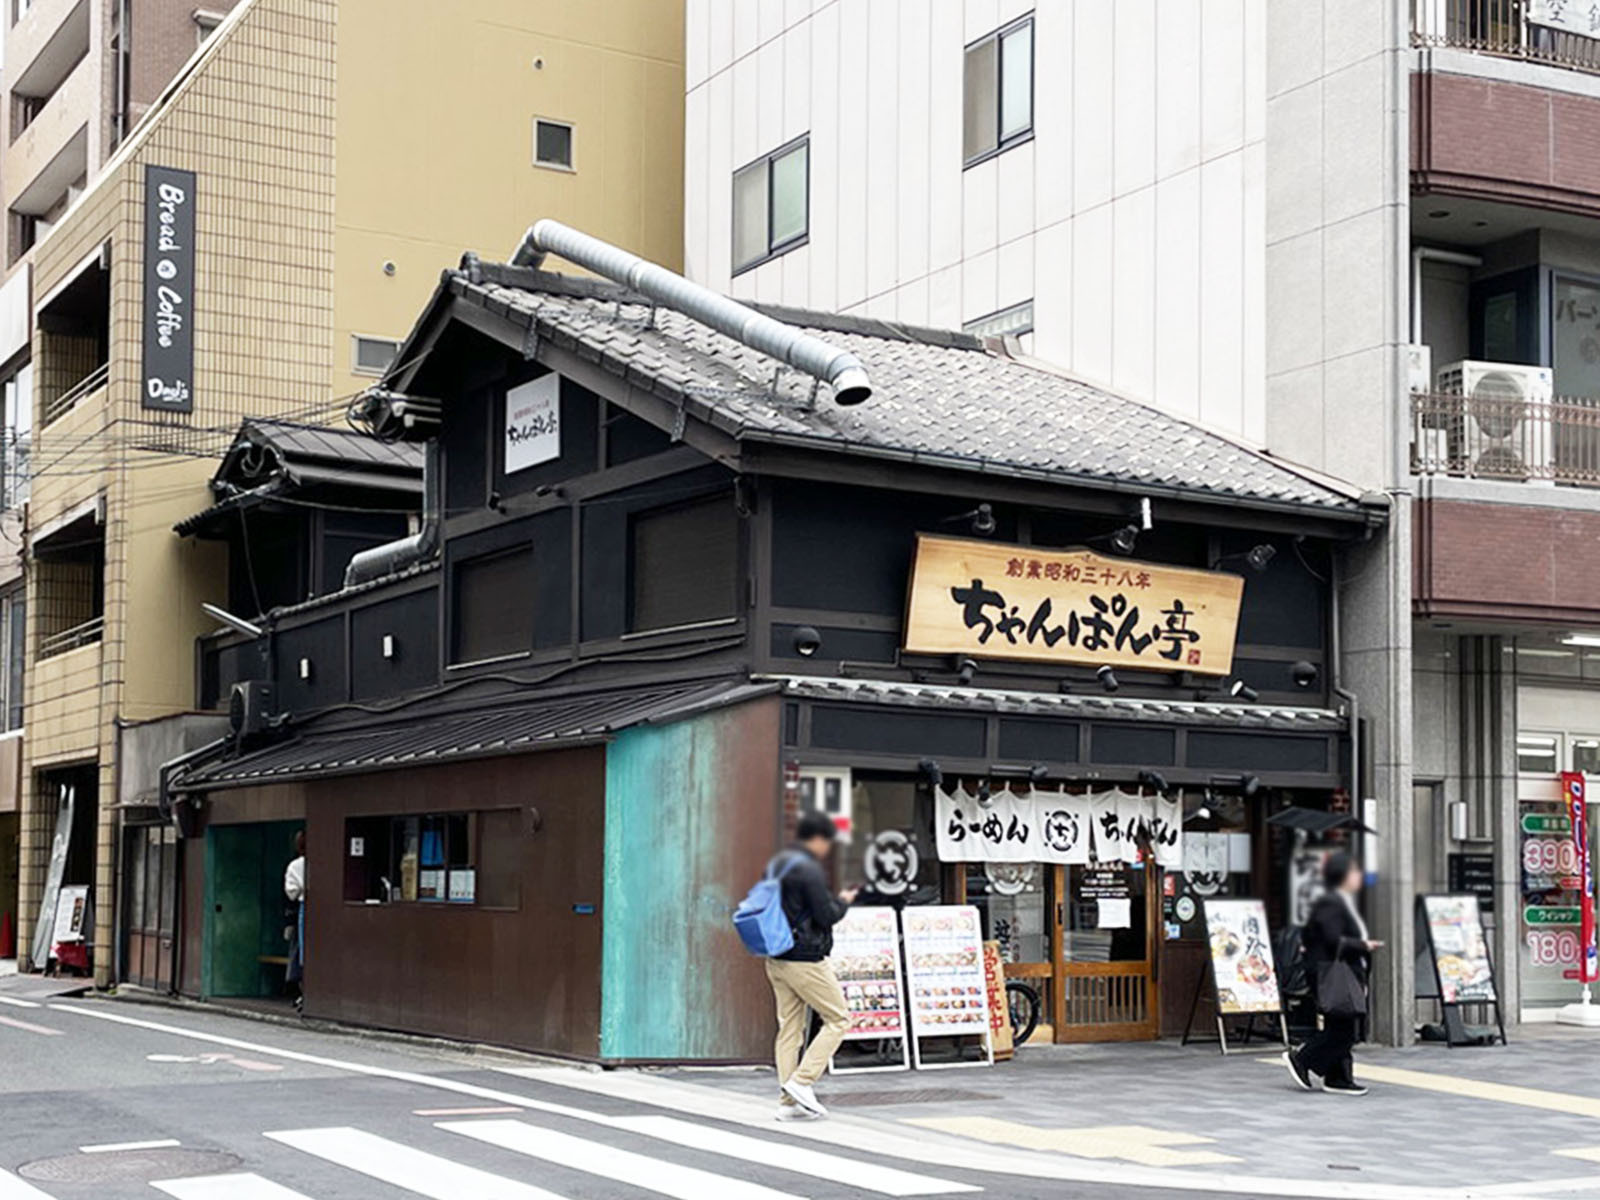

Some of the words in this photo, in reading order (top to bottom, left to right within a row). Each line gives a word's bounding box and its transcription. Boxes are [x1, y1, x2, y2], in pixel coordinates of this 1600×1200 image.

[158, 183, 184, 251] Bread
[156, 285, 182, 347] Coffee
[1005, 557, 1151, 589] 創業昭和三十八年
[951, 578, 1200, 660] ちゃんぽん亭
[949, 808, 1029, 844] らーめん
[1526, 931, 1577, 966] 180
